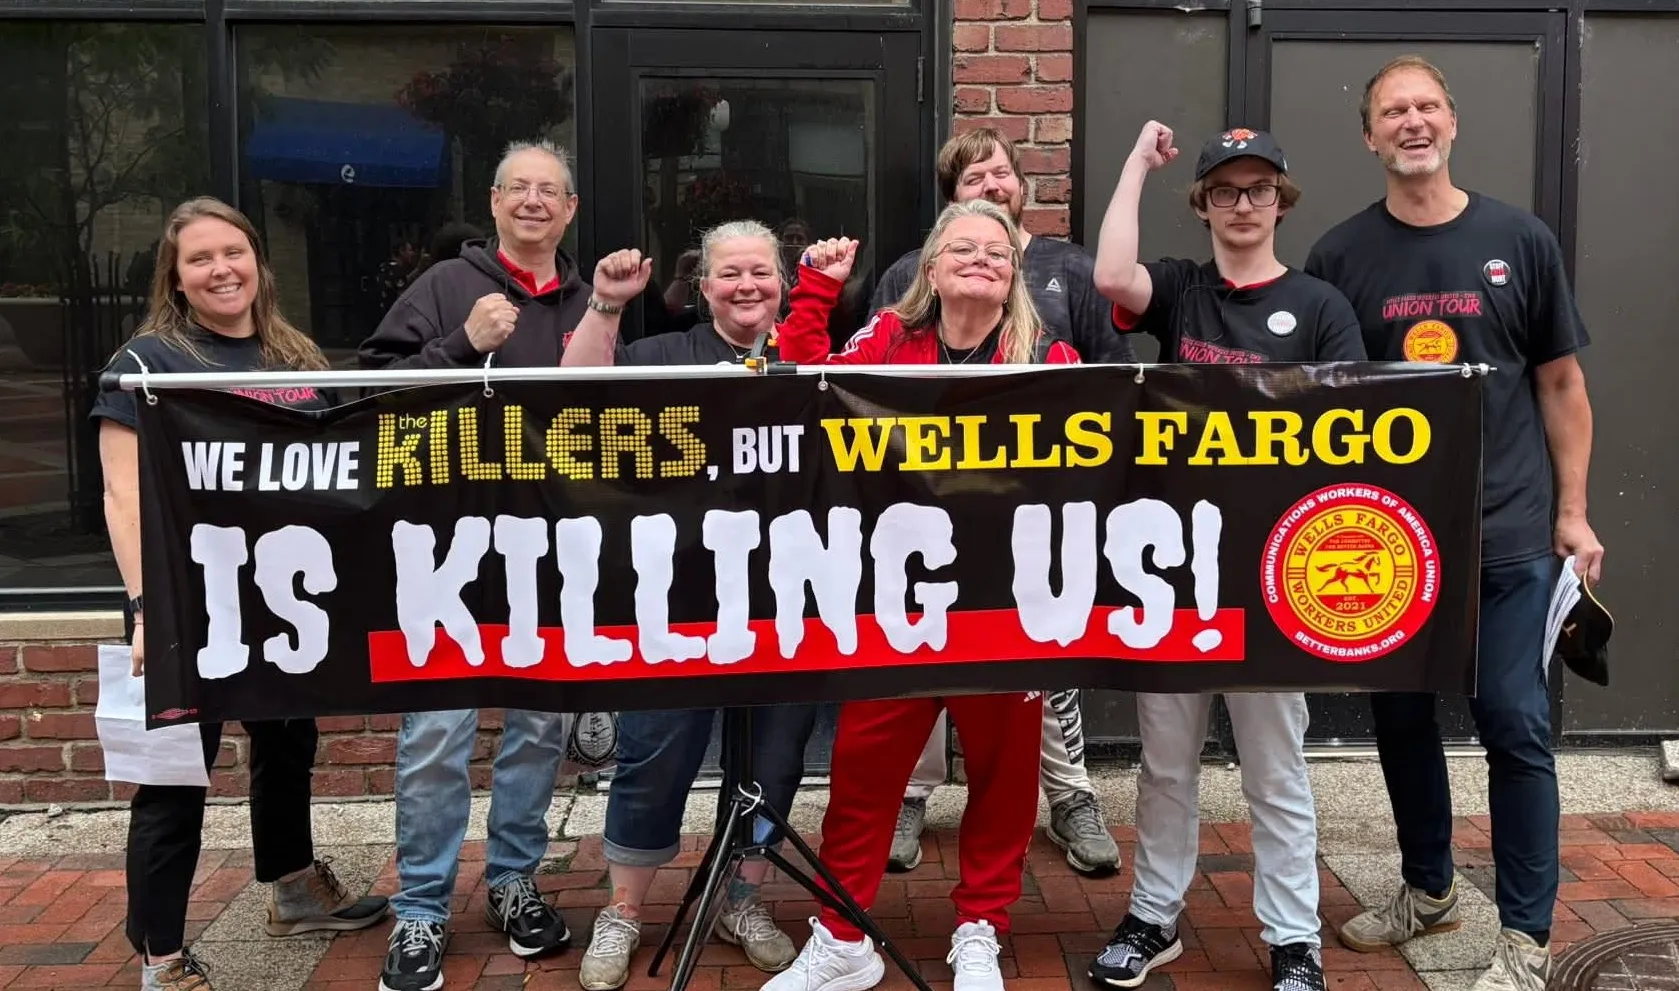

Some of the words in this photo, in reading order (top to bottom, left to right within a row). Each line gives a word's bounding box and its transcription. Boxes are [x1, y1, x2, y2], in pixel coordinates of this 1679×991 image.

[1382, 300, 1434, 321] UNION
[1437, 298, 1482, 316] TOUR
[399, 414, 428, 430] the
[181, 441, 246, 492] WE
[258, 441, 360, 492] LOVE
[732, 424, 805, 474] BUT
[820, 411, 1114, 473] WELLS
[1134, 407, 1432, 466] FARGO
[1265, 498, 1316, 604] COMMUNICATIONS
[1317, 487, 1380, 503] WORKERS
[1381, 495, 1399, 508] OF
[1397, 506, 1434, 557] AMERICA
[1420, 559, 1436, 603] UNION
[1294, 513, 1345, 558] WELLS
[1355, 512, 1406, 556] FARGO
[190, 523, 338, 680] IS
[391, 502, 959, 668] KILLING
[1011, 497, 1223, 652] US!
[1292, 581, 1357, 633] WORKERS
[1363, 579, 1409, 629] UNITED
[1336, 601, 1367, 611] 2021
[1294, 630, 1406, 657] BETTERBANKS.ORG
